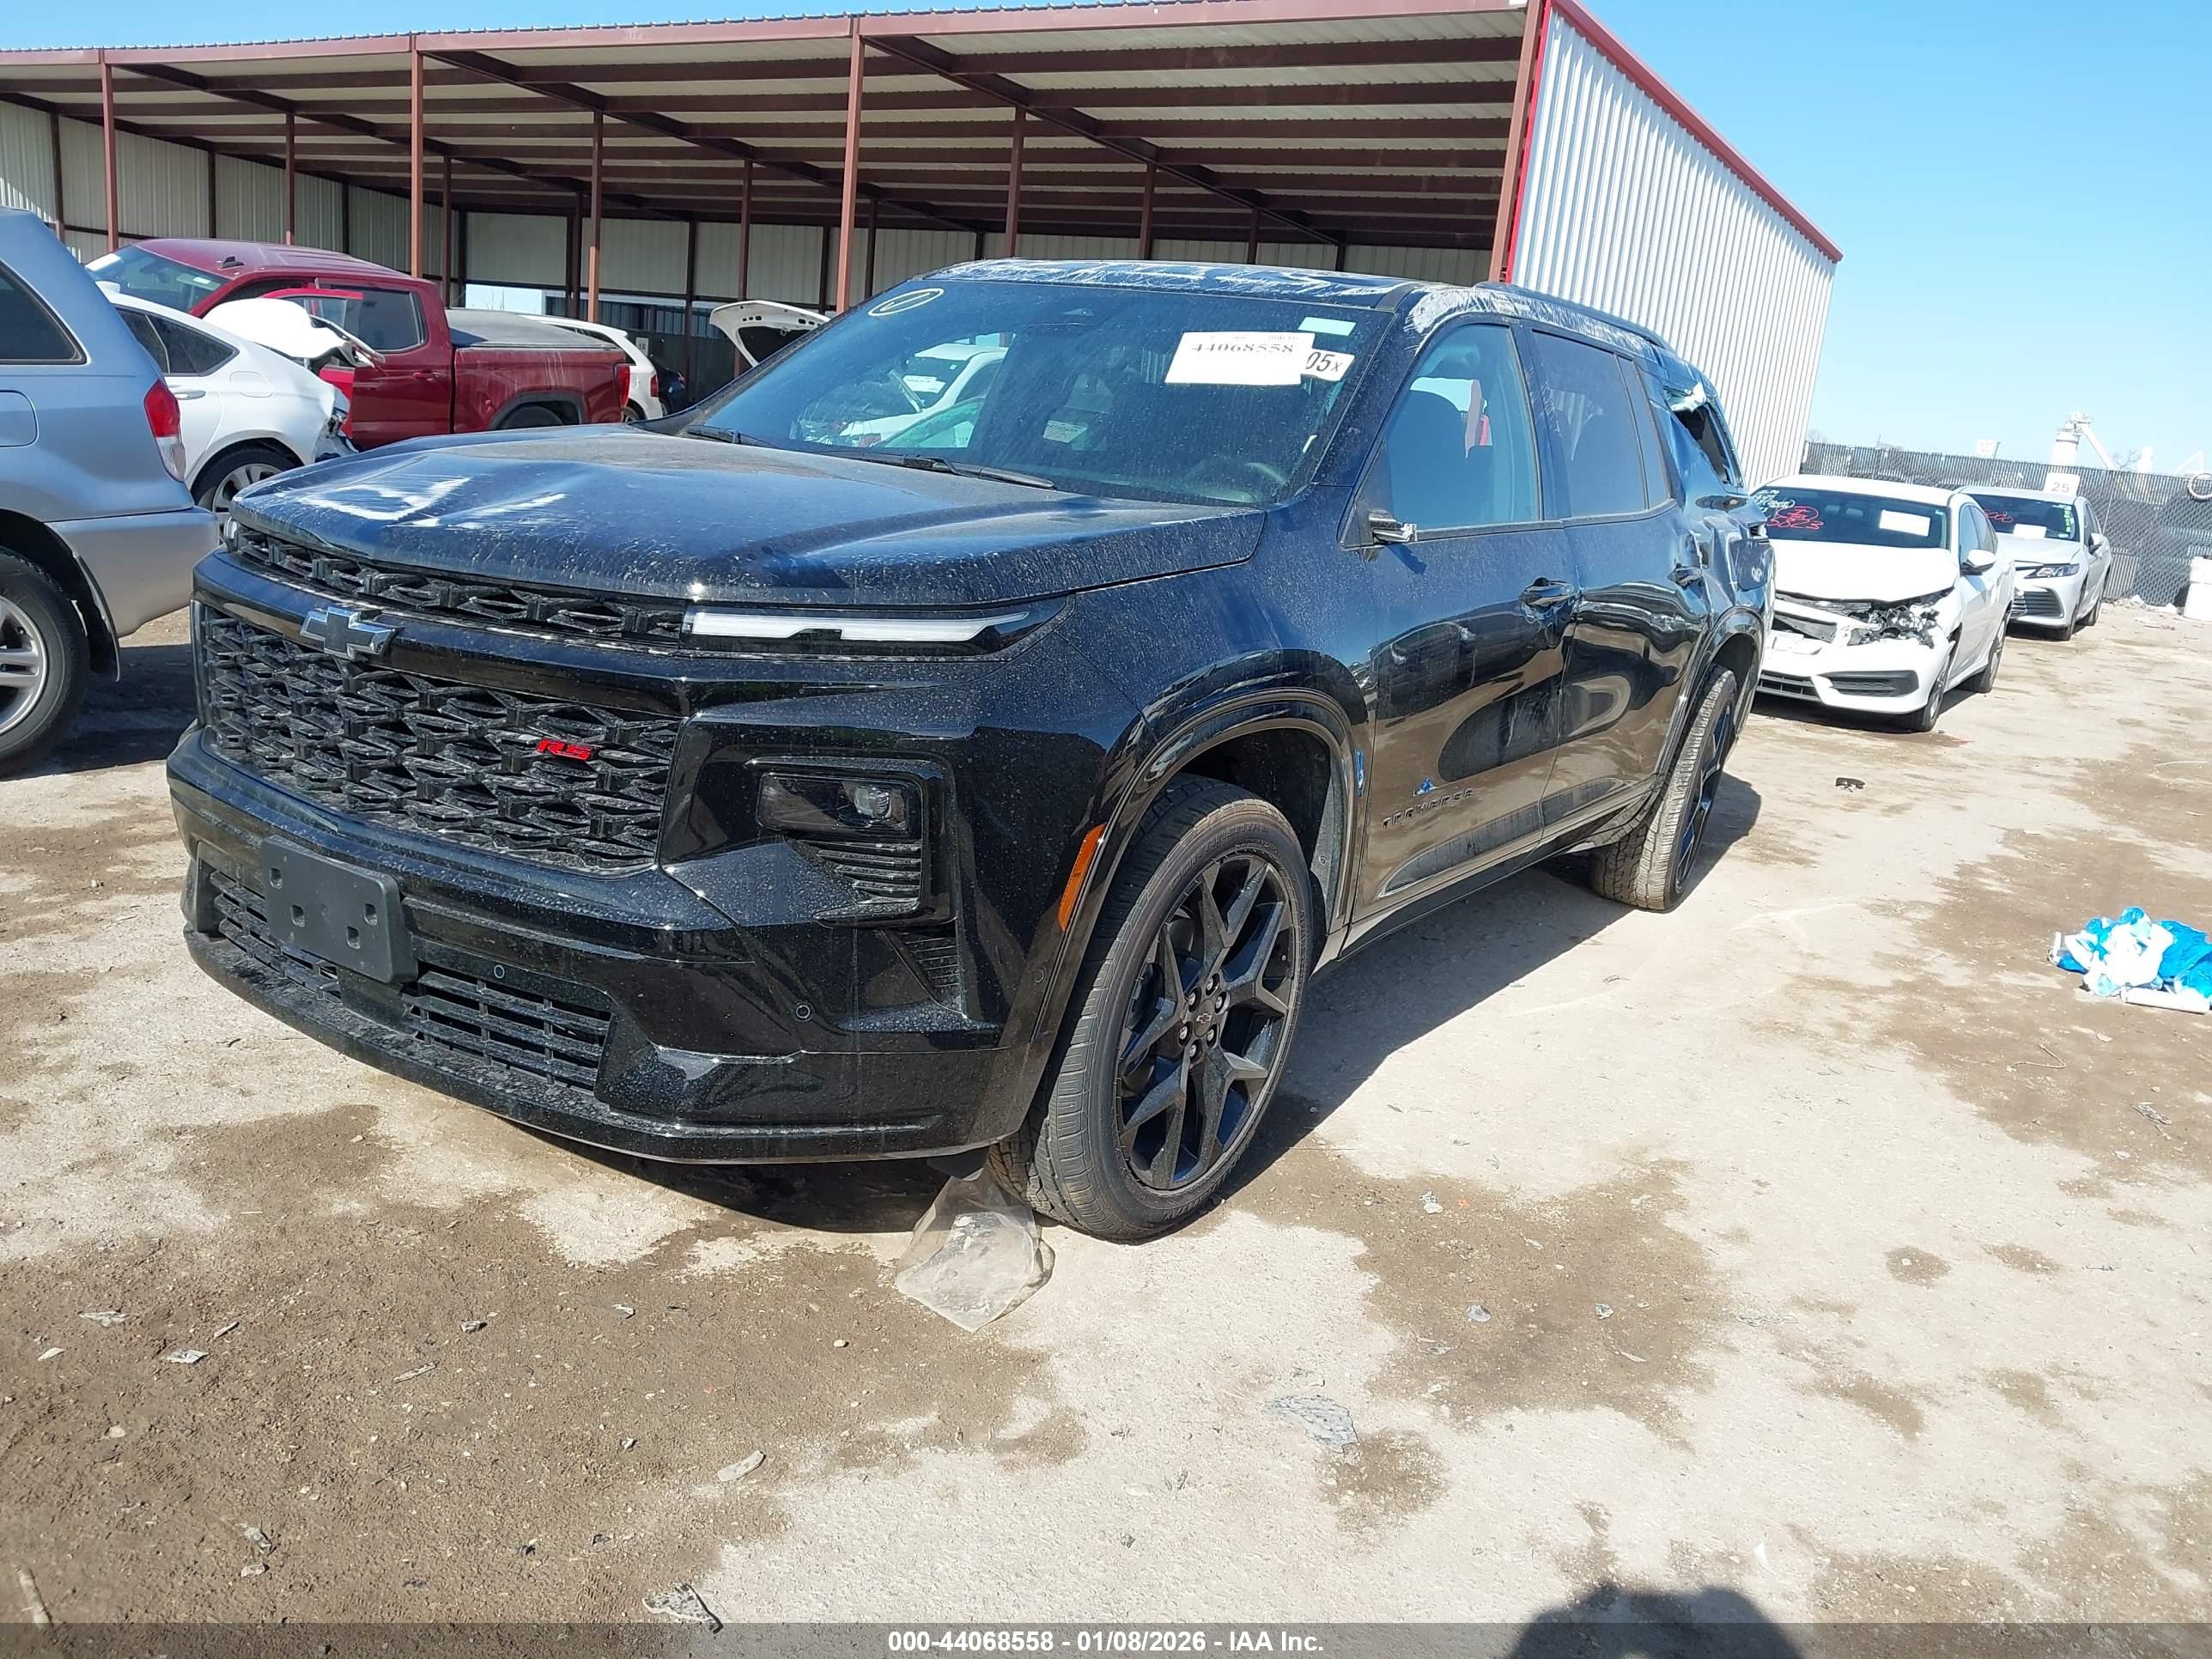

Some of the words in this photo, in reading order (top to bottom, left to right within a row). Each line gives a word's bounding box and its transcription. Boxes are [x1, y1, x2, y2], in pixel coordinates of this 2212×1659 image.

[1192, 342, 1294, 353] 44068558
[2051, 482, 2069, 493] 25
[537, 737, 592, 762] RS
